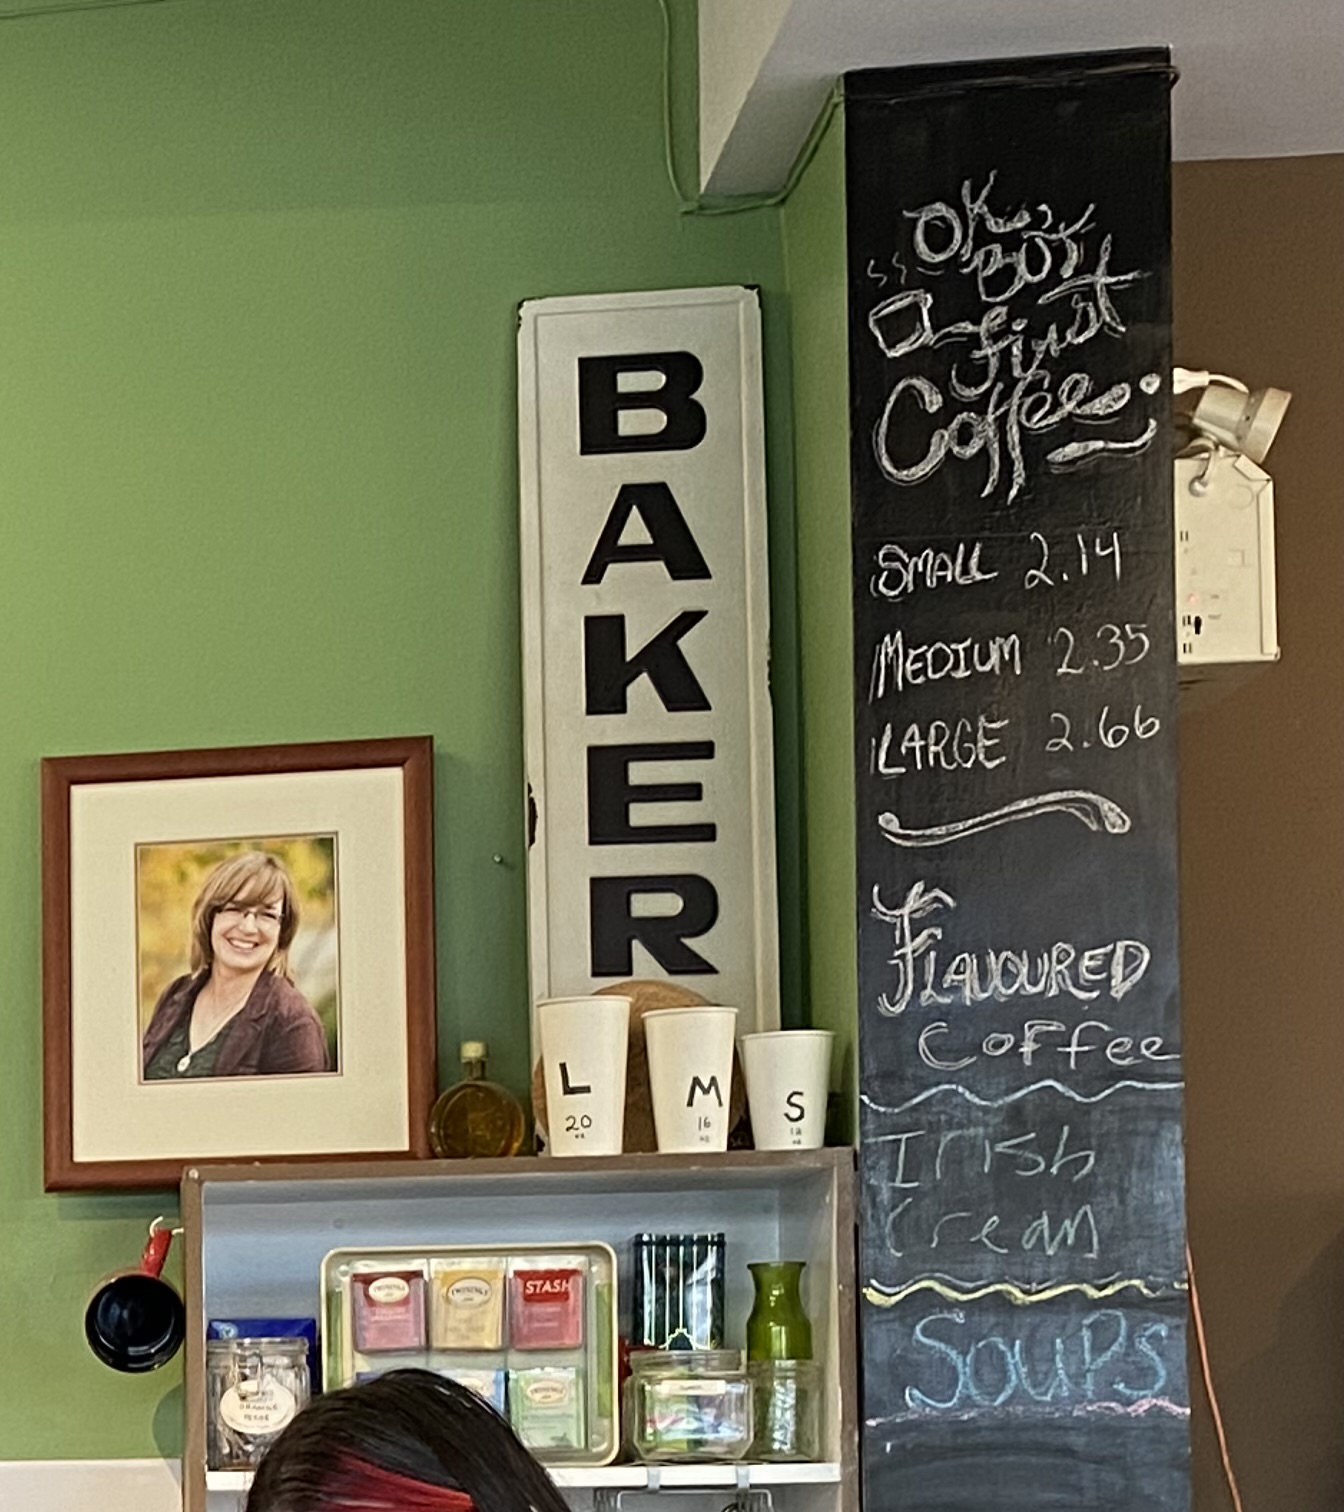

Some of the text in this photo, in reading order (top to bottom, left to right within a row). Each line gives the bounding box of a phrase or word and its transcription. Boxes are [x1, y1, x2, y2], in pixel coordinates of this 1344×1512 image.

[871, 541, 998, 598] SMALL
[869, 636, 1021, 703] MEDIUM
[870, 720, 1009, 776] LARGE
[871, 881, 1151, 1017] FLAVOURED
[559, 1062, 591, 1095] L
[687, 1076, 723, 1107] M
[566, 1114, 592, 1132] 20
[783, 1091, 805, 1122] S
[525, 1279, 572, 1294] STASH
